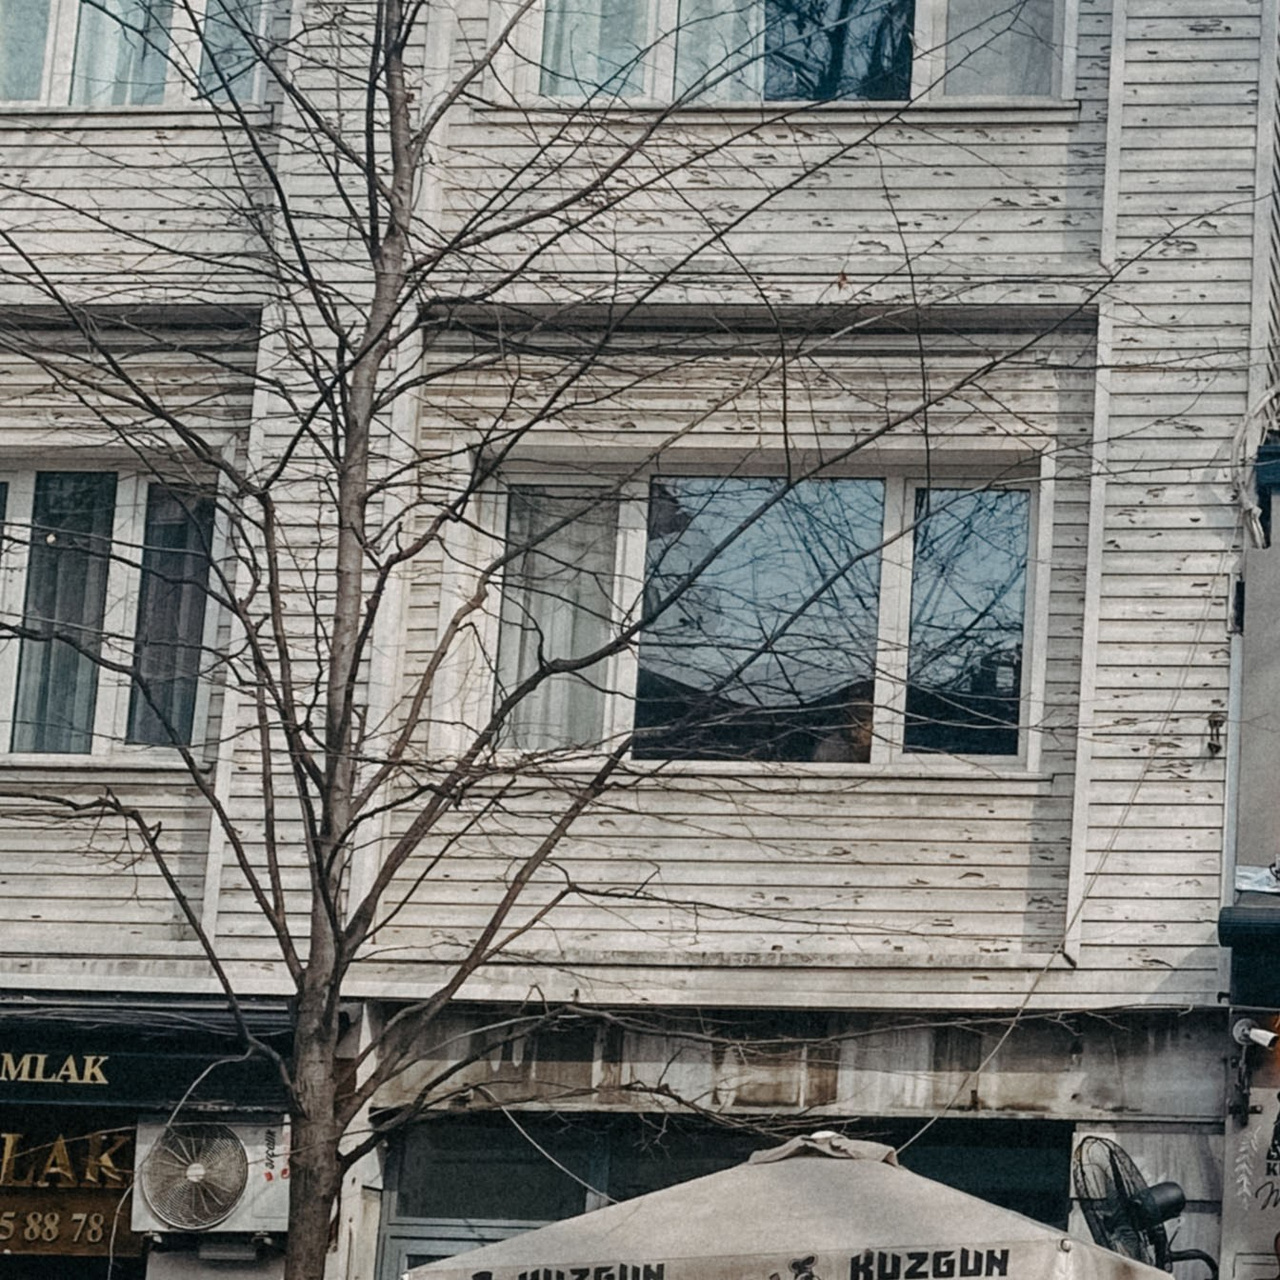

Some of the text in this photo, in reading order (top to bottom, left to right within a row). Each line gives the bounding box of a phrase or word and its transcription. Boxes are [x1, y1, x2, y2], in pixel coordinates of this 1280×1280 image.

[0, 1052, 109, 1084] MLAK
[0, 1133, 132, 1189] LAK
[24, 1211, 60, 1241] 88
[71, 1212, 105, 1243] 78
